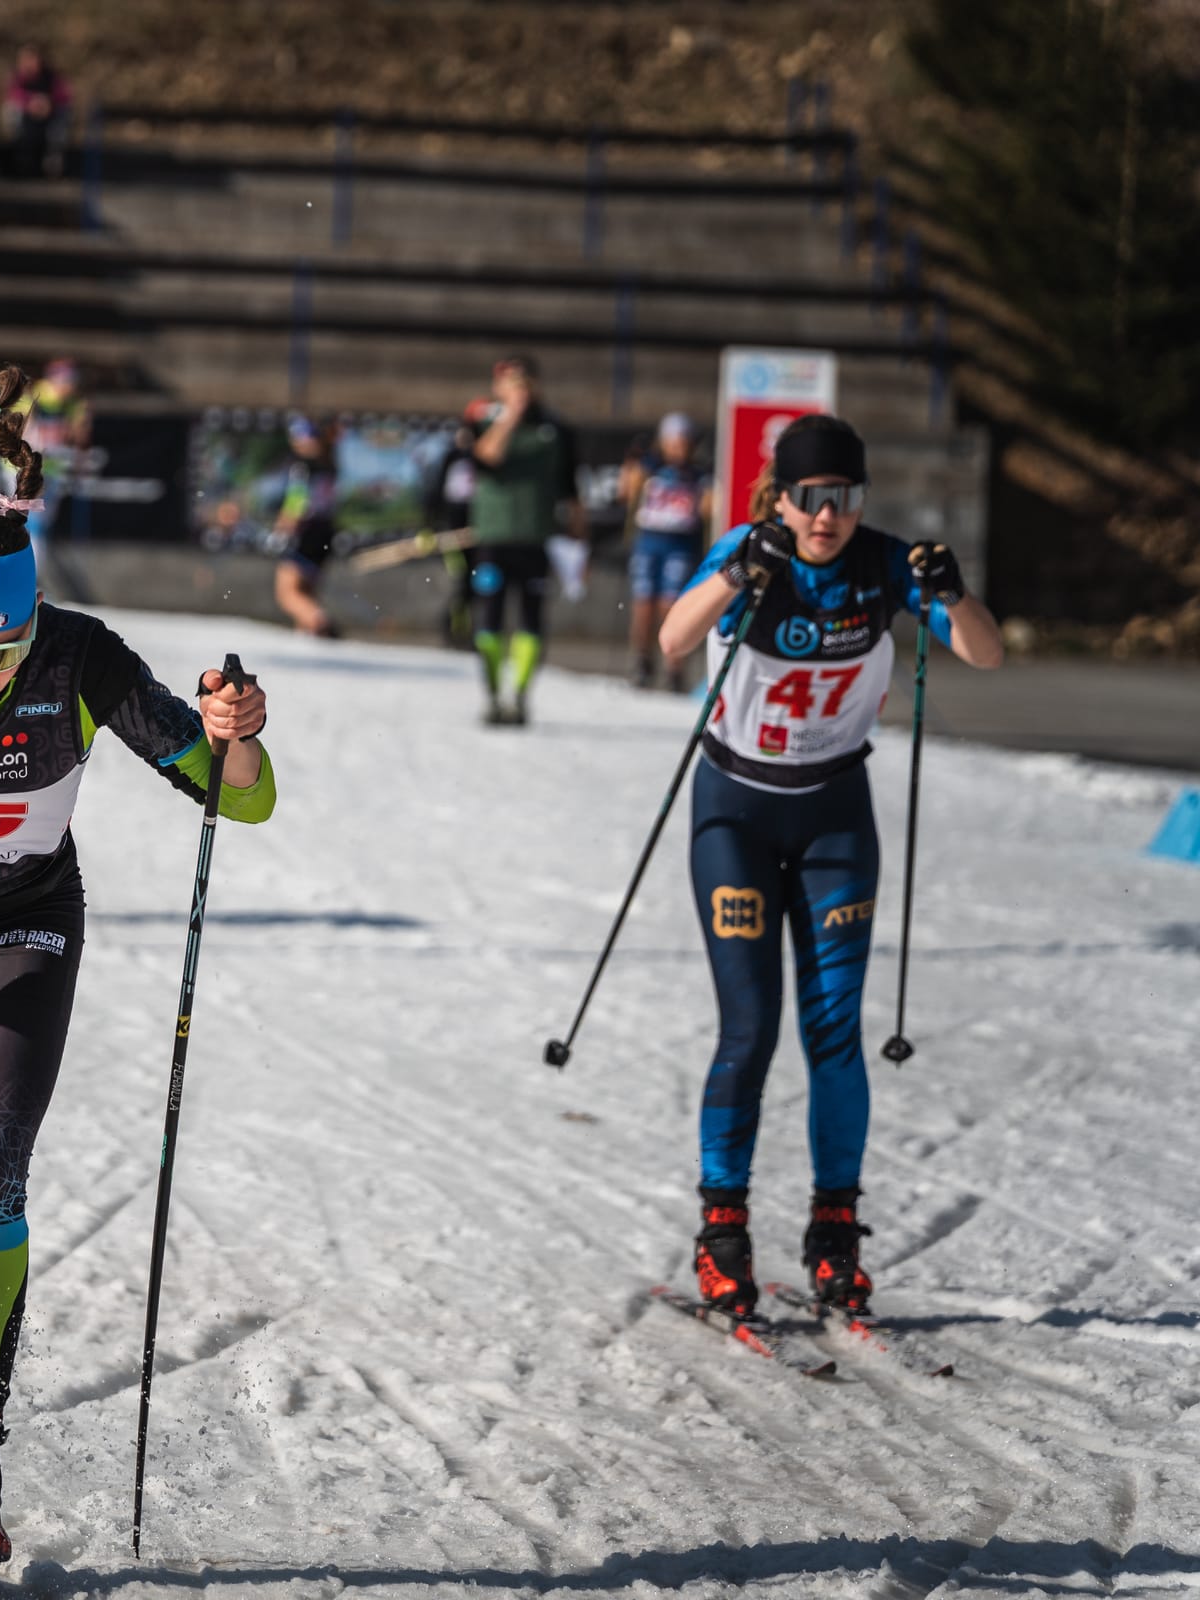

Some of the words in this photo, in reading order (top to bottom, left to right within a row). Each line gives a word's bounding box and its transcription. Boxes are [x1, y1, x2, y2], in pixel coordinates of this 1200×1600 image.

[765, 664, 864, 719] 47
[18, 704, 60, 715] PINGU
[27, 930, 66, 950] RACER
